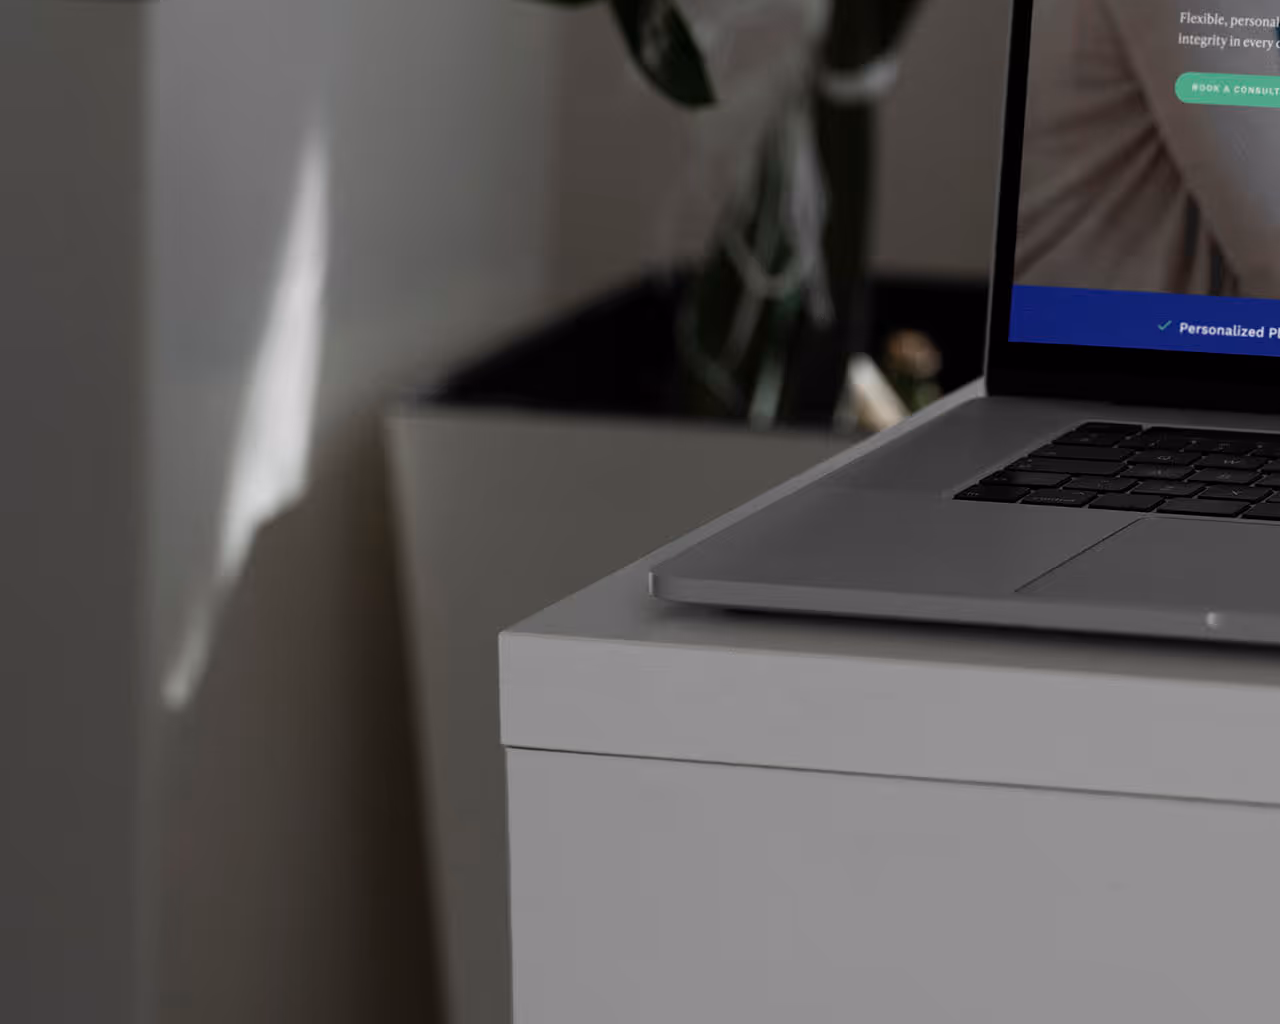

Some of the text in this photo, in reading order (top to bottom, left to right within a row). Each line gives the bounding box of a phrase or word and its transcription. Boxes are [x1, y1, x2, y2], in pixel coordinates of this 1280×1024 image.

[1180, 12, 1228, 26] Flexible,
[1178, 33, 1228, 49] integrity
[1229, 36, 1241, 47] in
[1243, 38, 1274, 51] every
[1191, 83, 1219, 93] BOOK
[1223, 85, 1231, 93] A
[1179, 322, 1265, 338] Personalized
